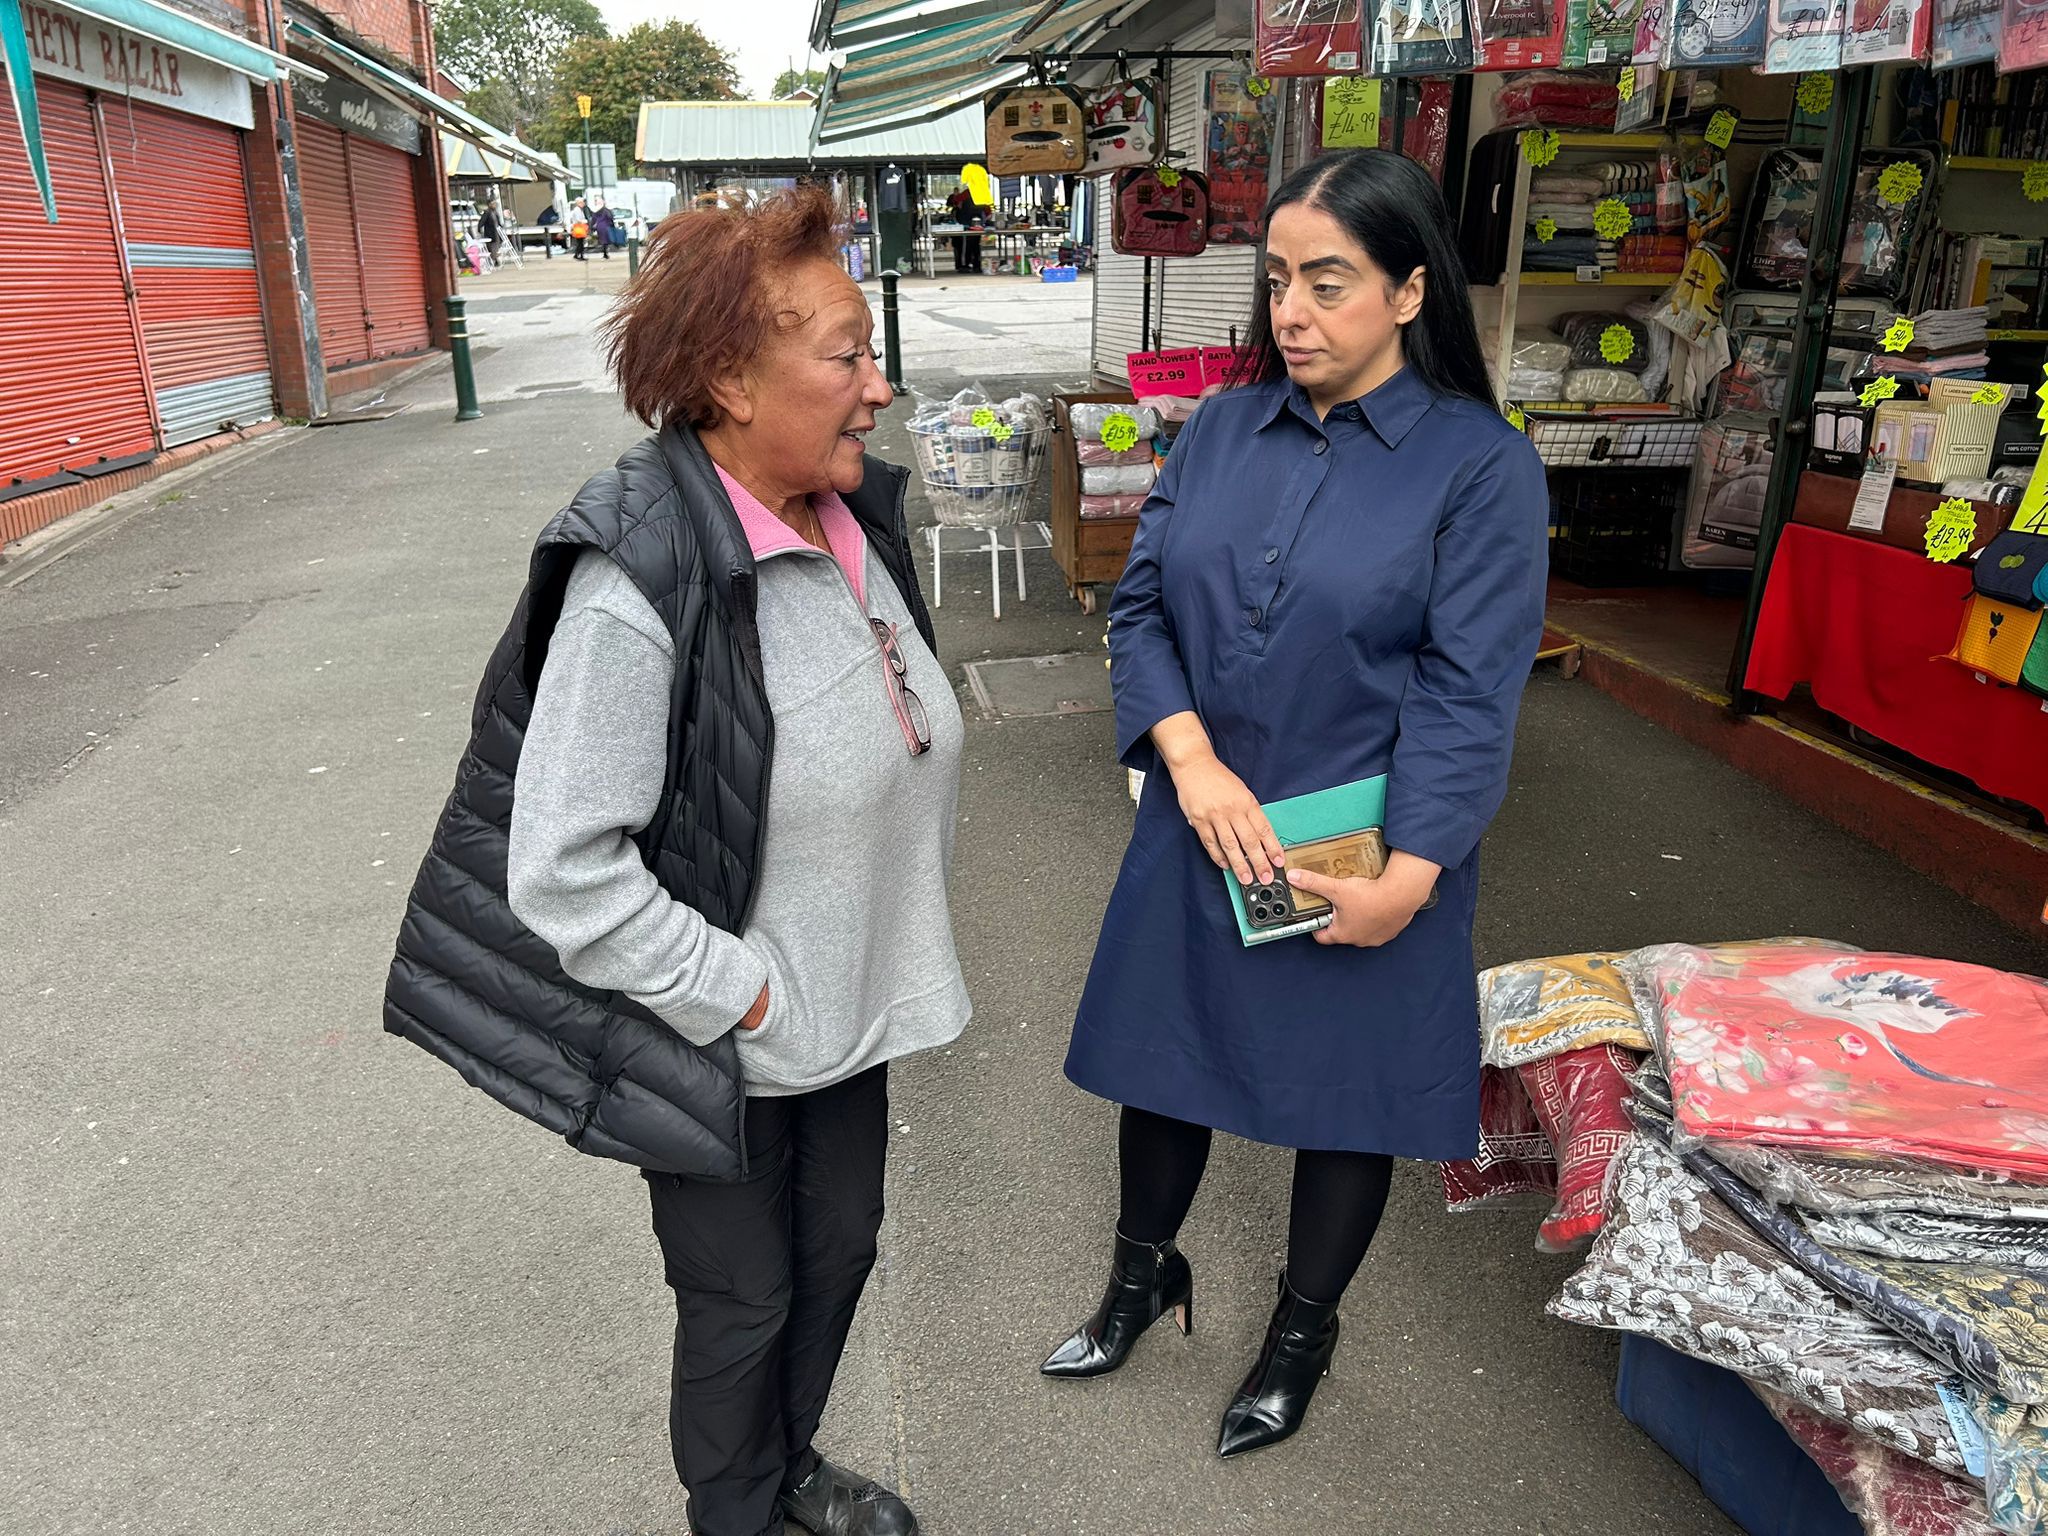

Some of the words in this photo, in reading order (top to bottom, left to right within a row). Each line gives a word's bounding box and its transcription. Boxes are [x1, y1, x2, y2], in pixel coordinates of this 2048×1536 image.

[1493, 12, 1526, 20] Liverpool
[1527, 11, 1536, 19] FC
[98, 30, 183, 96] BAZAR
[1334, 76, 1369, 90] RUGS
[341, 98, 377, 131] mela
[1753, 257, 1776, 266] Elvira
[1131, 357, 1157, 367] HAND
[1160, 352, 1195, 364] TOWELS
[1207, 352, 1232, 360] BATH
[1147, 369, 1186, 382] £2.99
[1705, 526, 1727, 536] KAREN
[1953, 1416, 1973, 1448] PLUSHY
